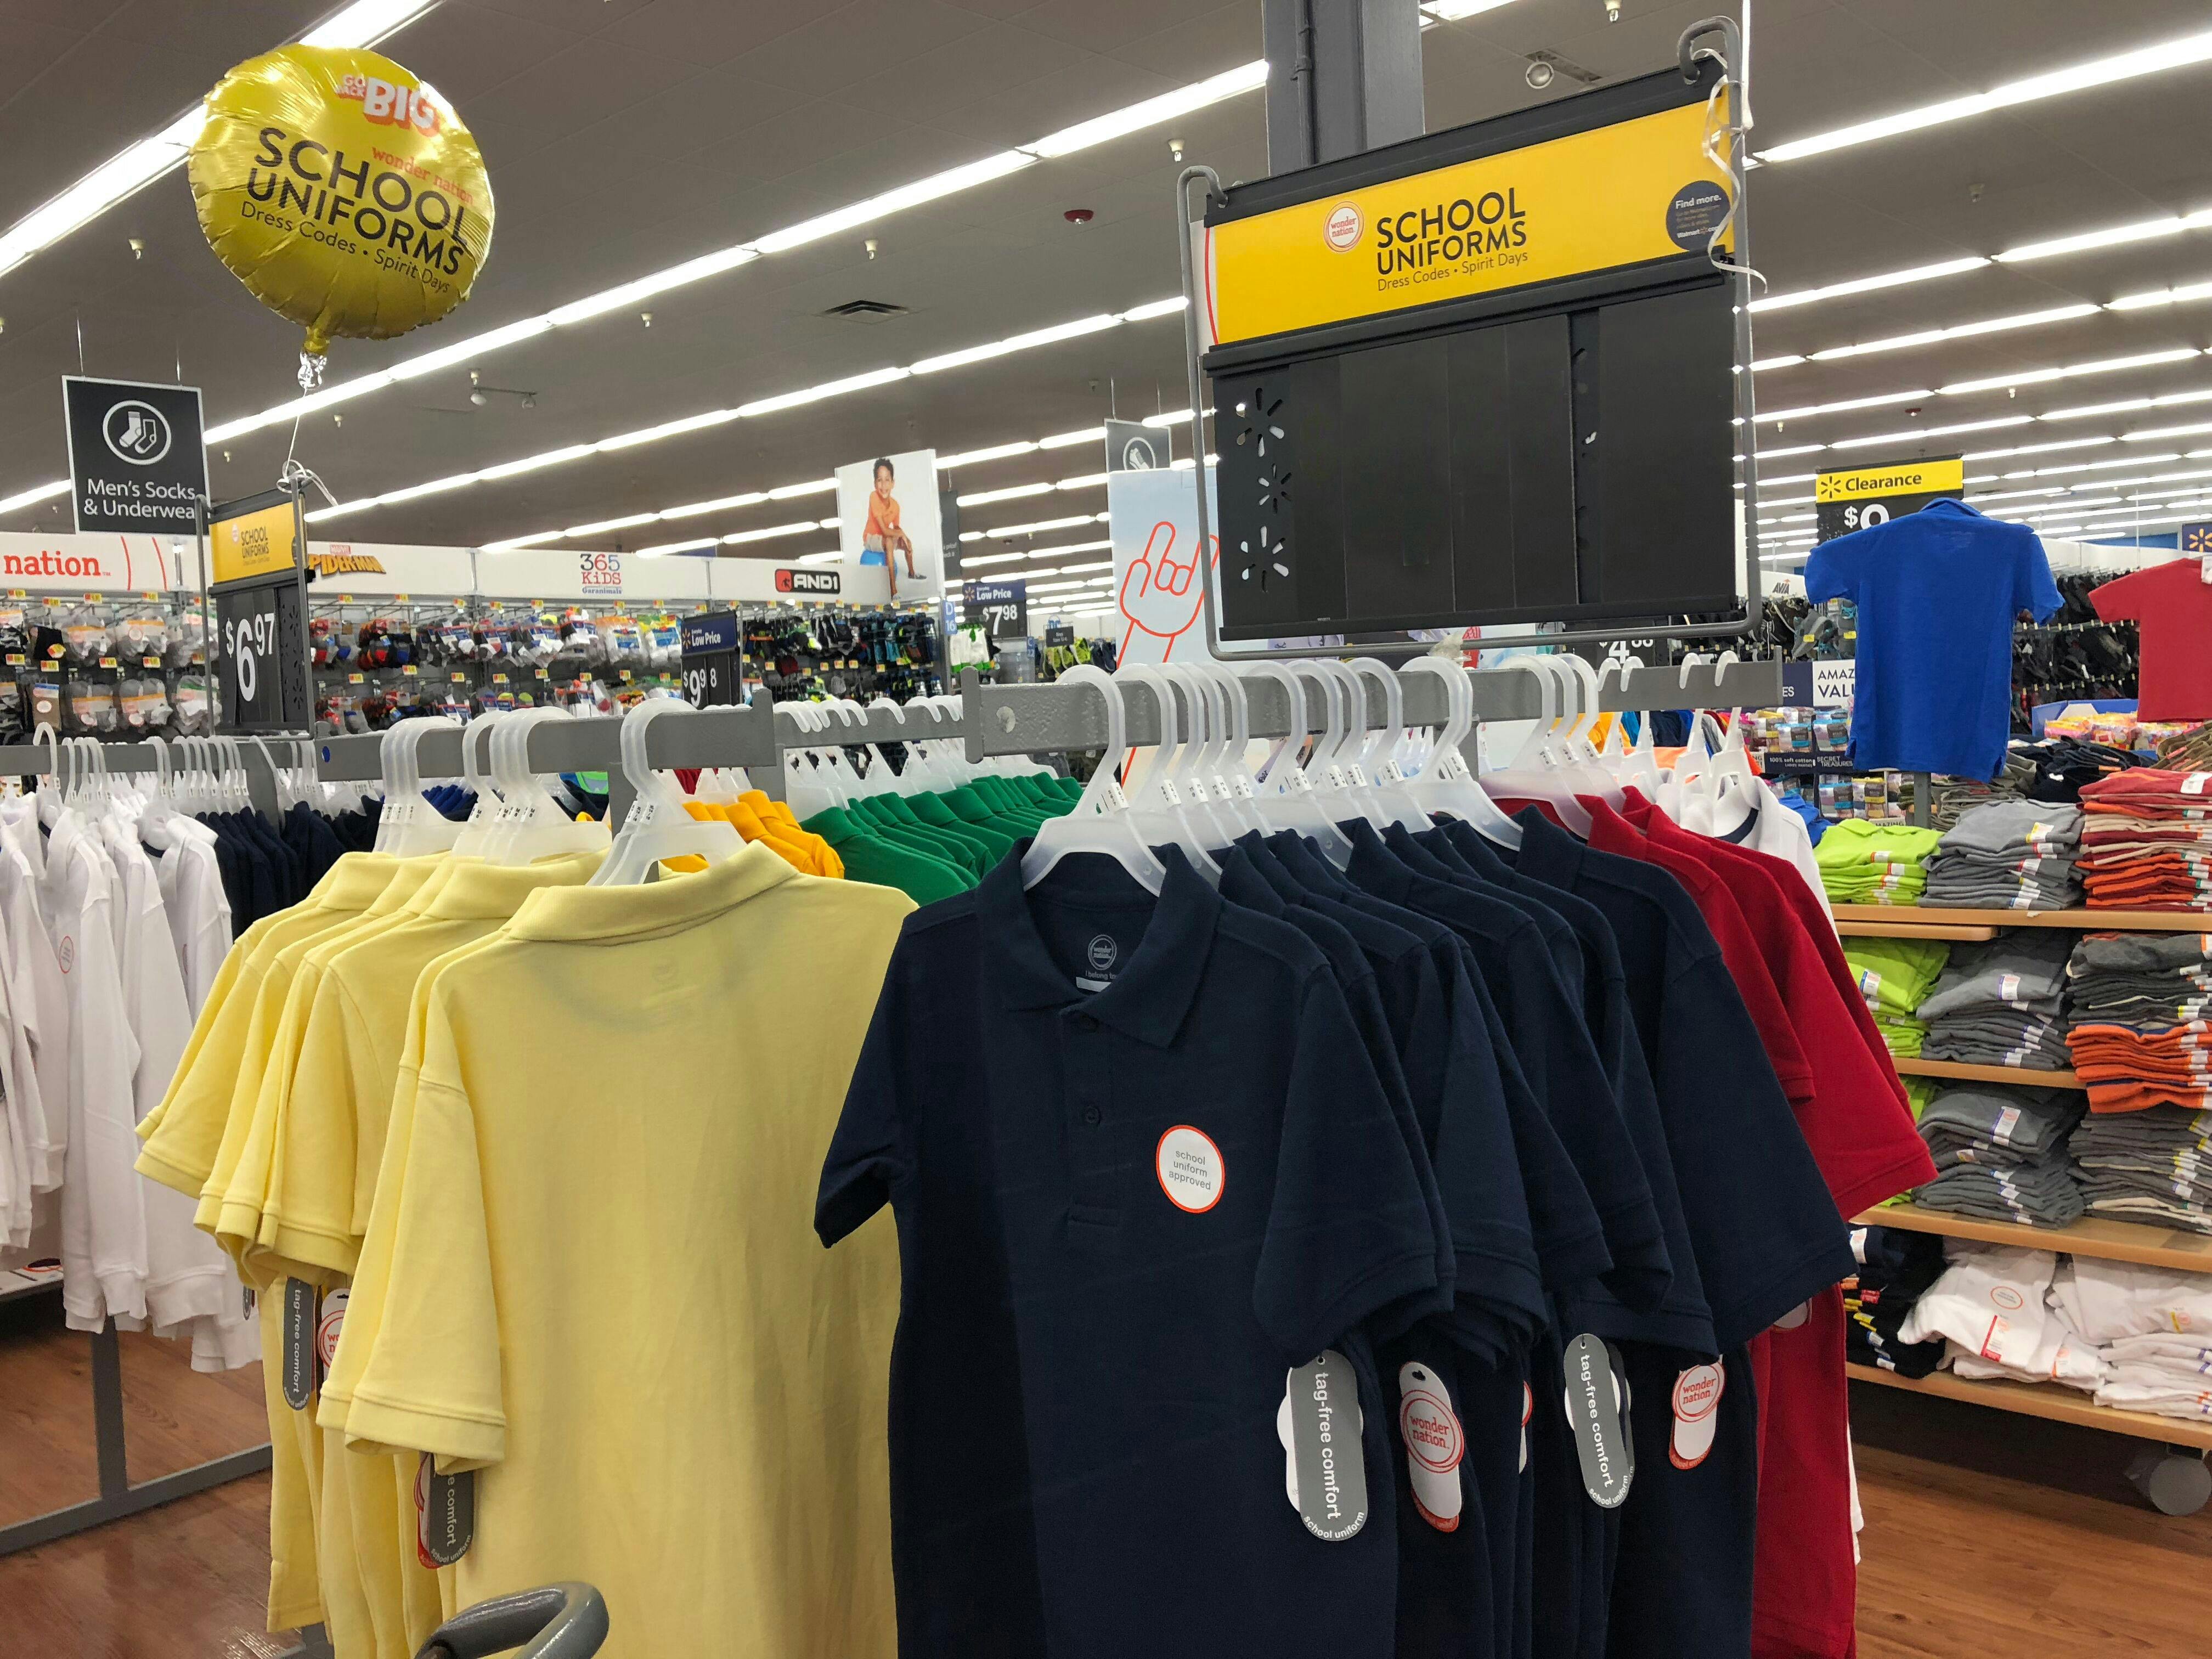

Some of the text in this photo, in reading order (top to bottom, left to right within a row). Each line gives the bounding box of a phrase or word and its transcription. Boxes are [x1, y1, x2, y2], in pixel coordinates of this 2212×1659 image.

[364, 77, 437, 133] BIG
[372, 146, 473, 205] wonder nation
[254, 127, 468, 245] SCHOOL
[1675, 194, 1722, 210] Find more.
[247, 168, 465, 275] UNIFORMS
[1330, 217, 1357, 229] wonder
[1377, 187, 1526, 248] SCHOOL
[241, 201, 450, 294] Dress Codes Spirit Days
[1378, 221, 1526, 275] UNIFORMS
[1378, 251, 1528, 291] Dress Codes Spirit Days
[88, 478, 195, 500] Men's Socks
[1846, 474, 1922, 492] Clearance
[84, 499, 195, 519] & Underwea
[241, 527, 268, 546] SCHOOL
[242, 543, 269, 558] UNIFORMS
[4, 550, 100, 576] nation
[308, 553, 386, 576] PIDER-MAN
[580, 554, 620, 571] 365
[794, 574, 838, 590] AND1
[1773, 583, 1789, 594] AVIA
[977, 589, 1012, 601] Low Price
[945, 602, 953, 616] D
[946, 620, 956, 631] 16
[692, 631, 721, 647] Low Price
[1088, 971, 1108, 980] belong
[1176, 1150, 1205, 1165] school
[1173, 1161, 1207, 1177] uniform
[1169, 1171, 1211, 1190] approved
[1683, 1376, 1716, 1394] wonder
[1409, 1415, 1449, 1435] wonder
[1580, 1354, 1614, 1488] tag-free comfort
[1313, 1372, 1341, 1520] tag-free comfort
[1588, 1475, 1628, 1505] school uniform
[447, 1488, 457, 1547] comfort
[1304, 1511, 1365, 1539] school uniform
[431, 1548, 449, 1563] school
[450, 1534, 471, 1561] uniform
